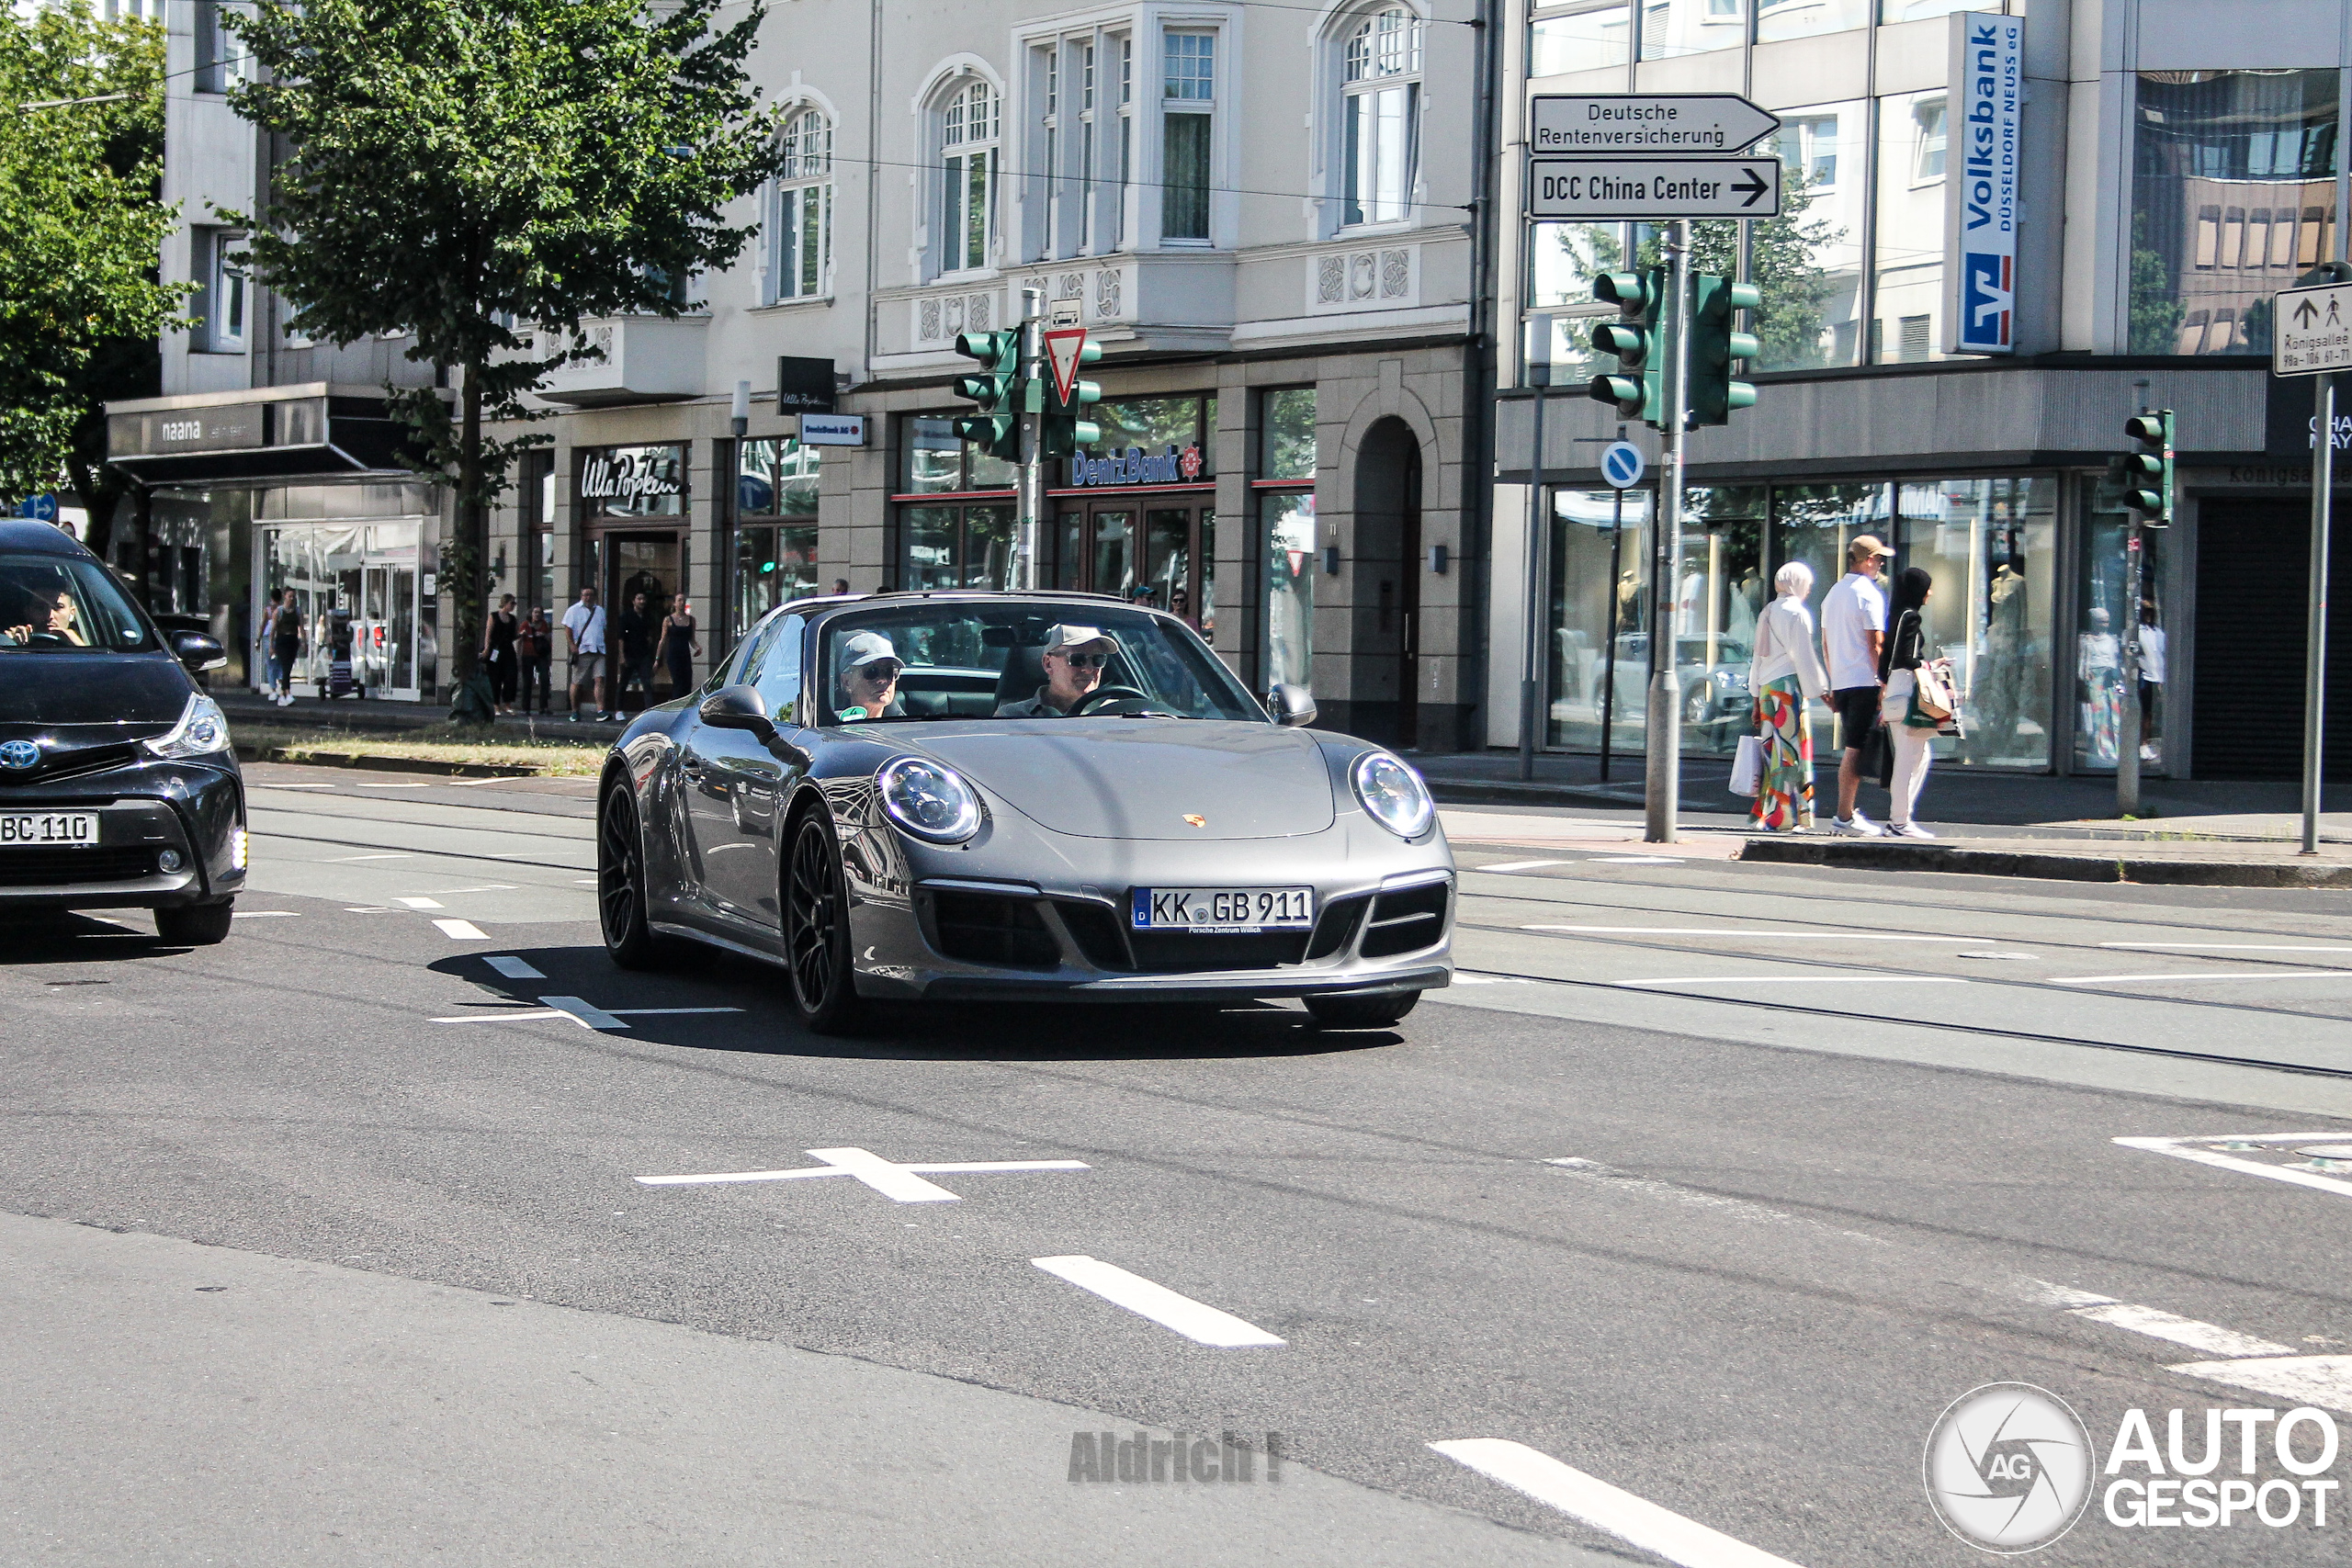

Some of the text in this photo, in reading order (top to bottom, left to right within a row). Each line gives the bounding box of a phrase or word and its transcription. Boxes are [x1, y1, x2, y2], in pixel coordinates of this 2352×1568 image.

[1589, 104, 1678, 121] Deutsche
[1540, 128, 1724, 147] Rentenversicherung
[1967, 25, 1996, 231] Volksbank
[1998, 28, 2017, 231] DÜSSELDORF NEUSS eG
[1544, 175, 1721, 200] DCC China Center
[2284, 333, 2348, 351] Königsallee
[163, 421, 201, 441] naana
[1072, 445, 1179, 486] DenizBank
[582, 454, 679, 511] Ulla Popken
[2, 817, 87, 840] BC 110
[1138, 911, 1146, 921] D
[1153, 892, 1309, 922] KK GB 911
